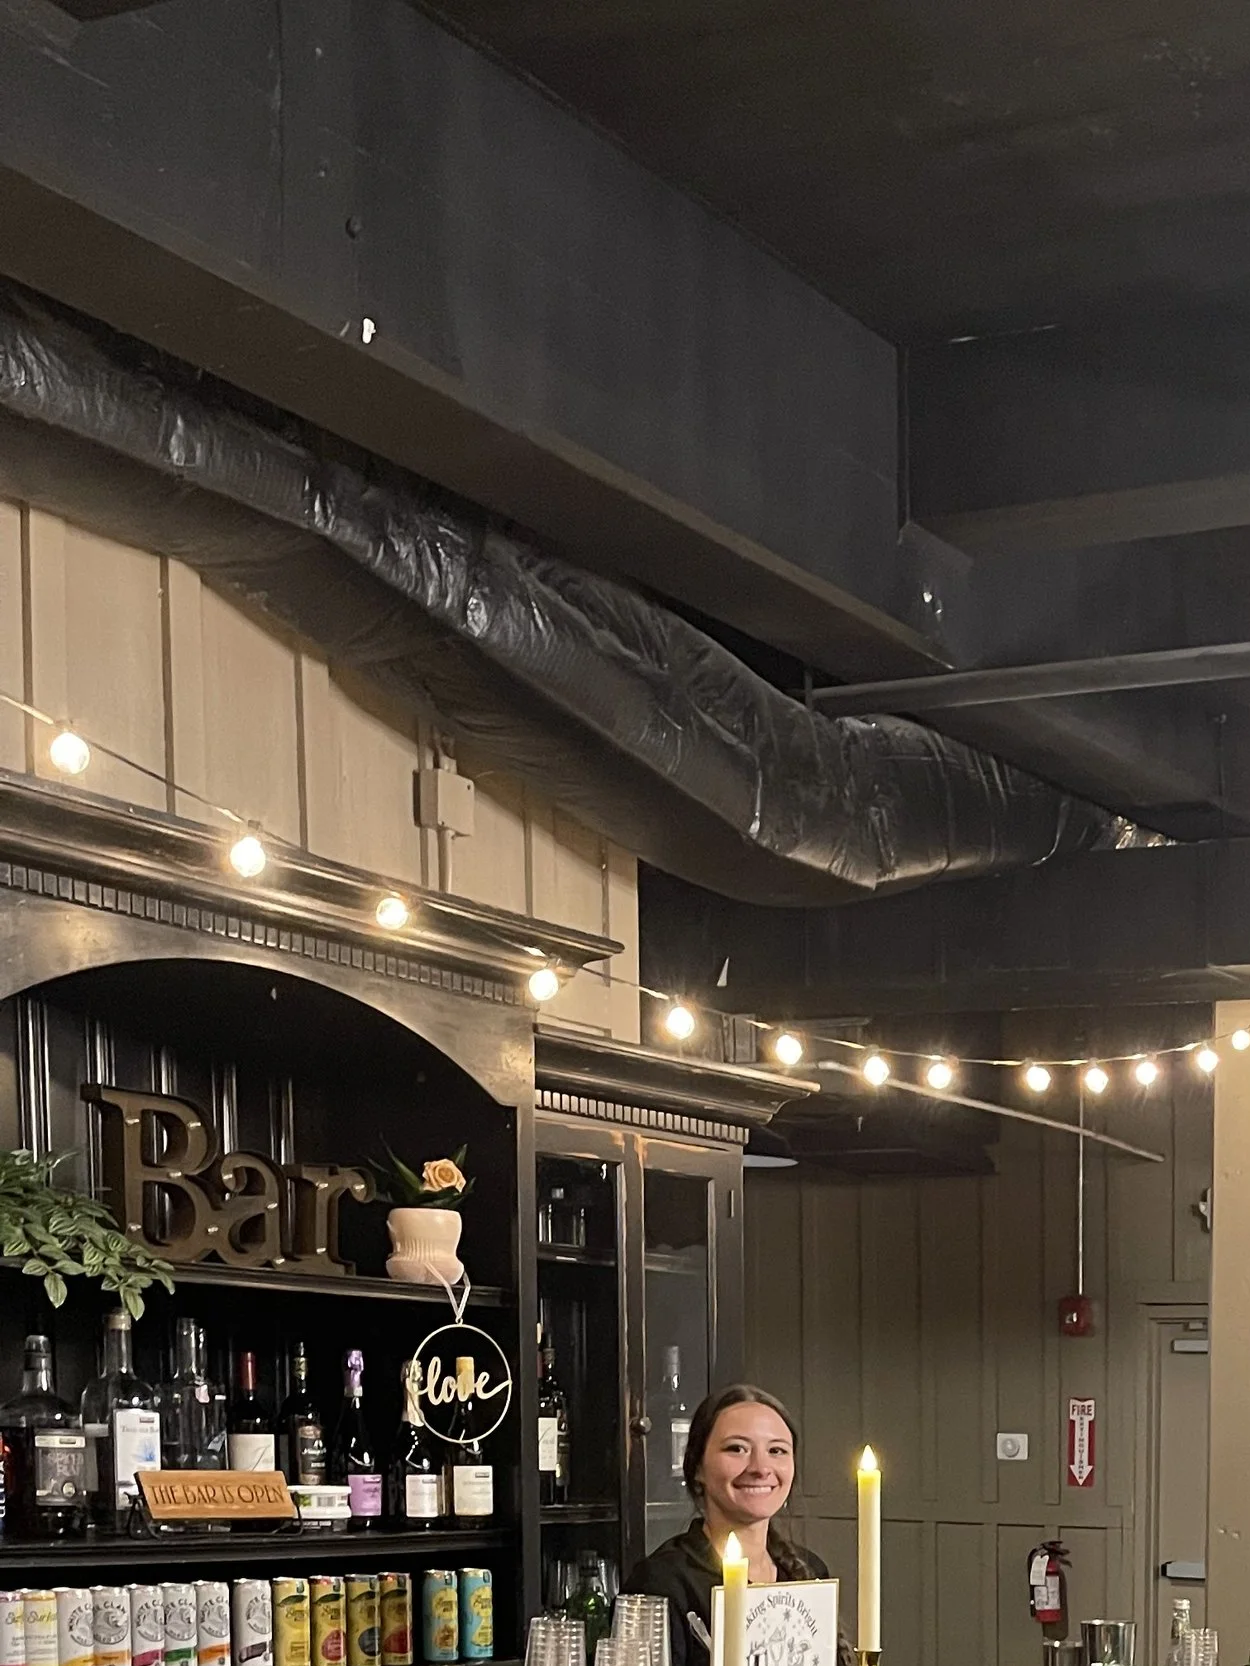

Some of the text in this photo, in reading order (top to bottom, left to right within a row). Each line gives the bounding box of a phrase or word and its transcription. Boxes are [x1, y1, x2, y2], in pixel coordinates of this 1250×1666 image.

[80, 1083, 376, 1277] Bar
[420, 1356, 509, 1406] love
[1071, 1404, 1093, 1416] FIRE
[150, 1483, 286, 1505] THE BAR IS OPEN
